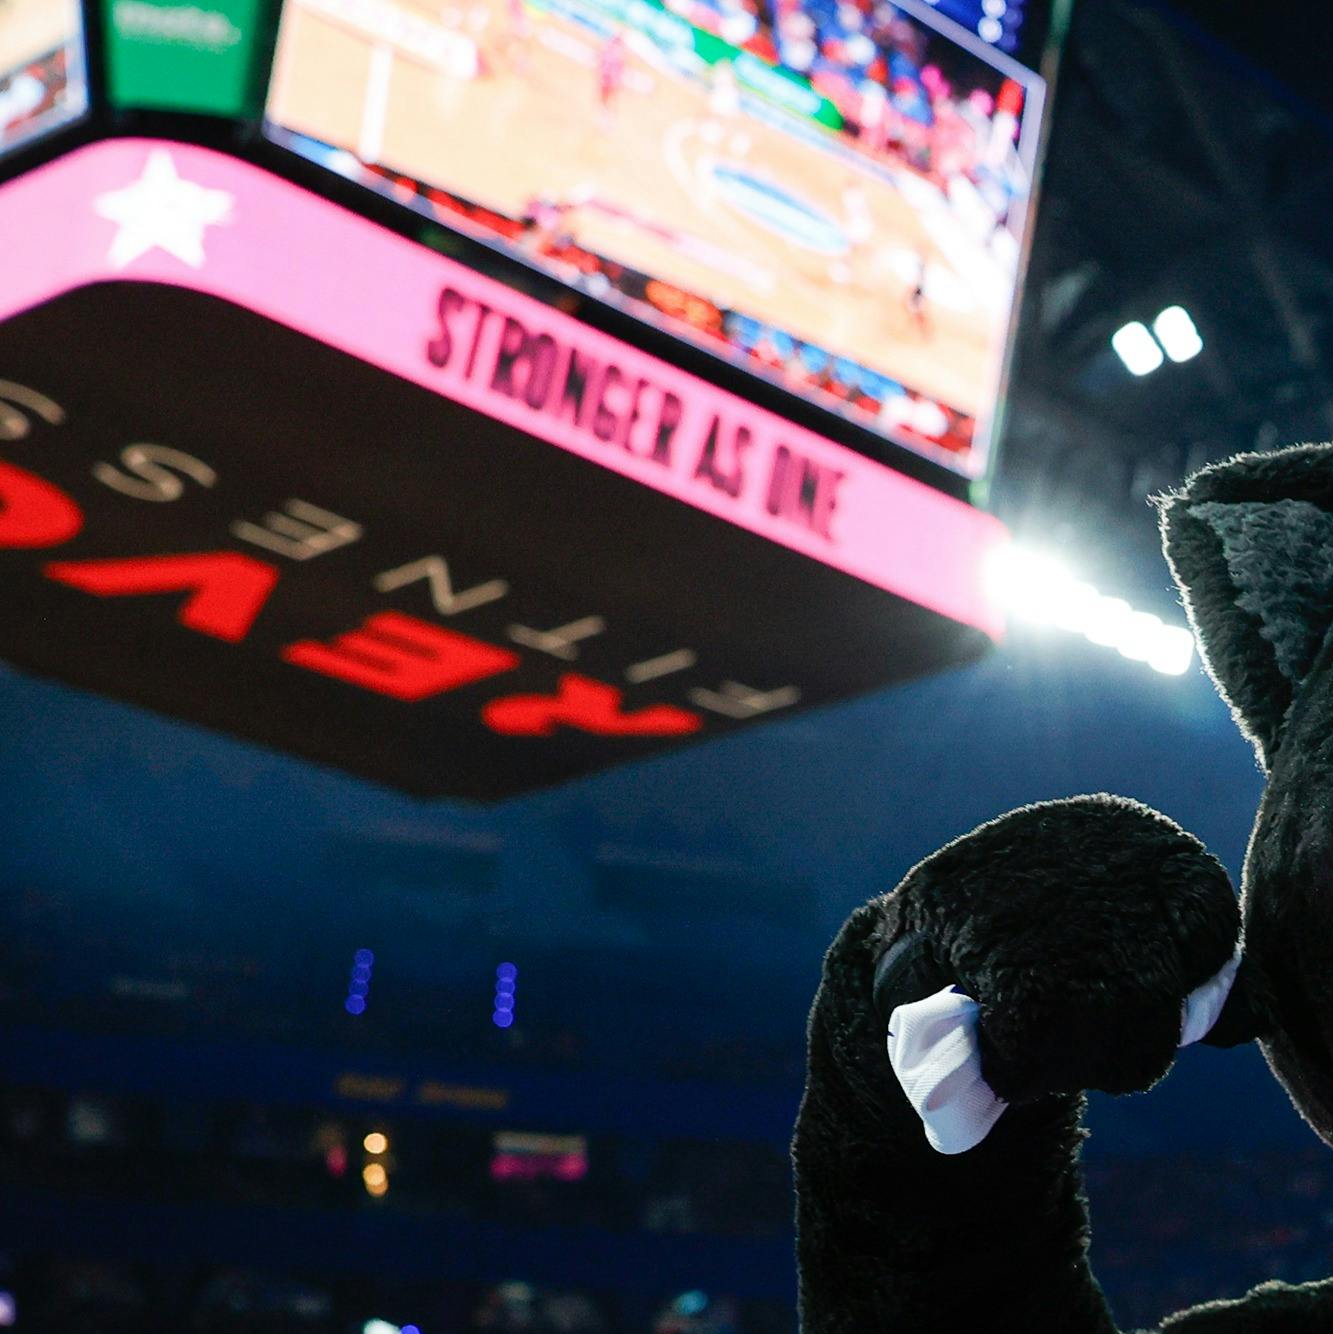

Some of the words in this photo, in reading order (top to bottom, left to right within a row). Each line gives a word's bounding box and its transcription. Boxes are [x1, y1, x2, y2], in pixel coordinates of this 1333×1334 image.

[427, 286, 684, 469] STRONGER
[694, 413, 753, 498] AS
[764, 443, 847, 544] ONE
